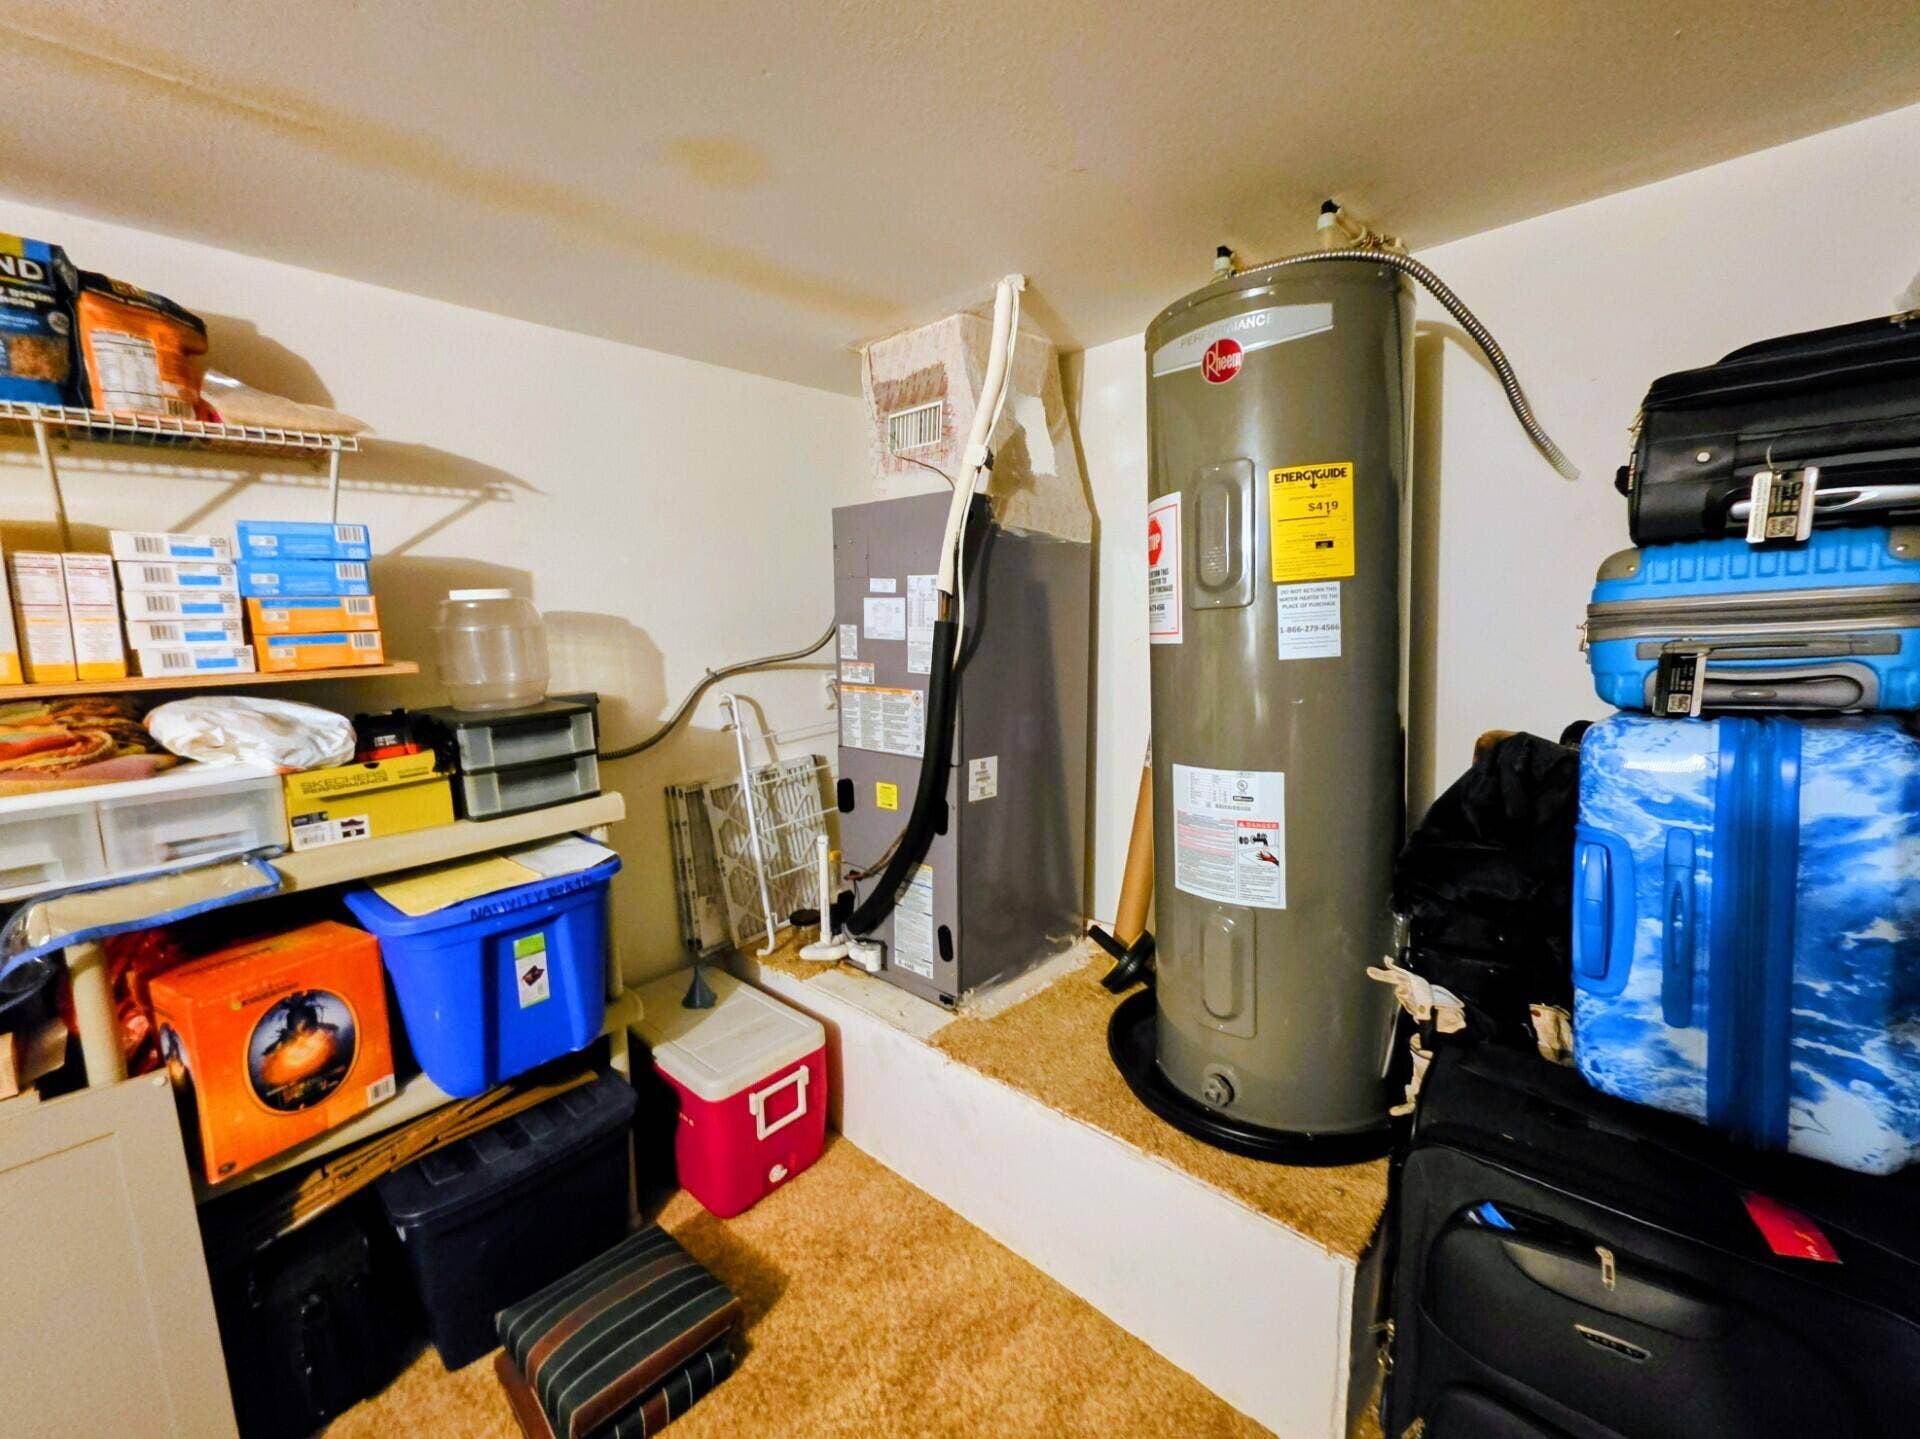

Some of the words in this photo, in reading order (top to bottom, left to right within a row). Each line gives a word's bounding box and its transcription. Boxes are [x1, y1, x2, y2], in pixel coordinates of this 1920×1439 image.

[1206, 341, 1241, 379] Rheem
[1274, 467, 1347, 485] ENERGYGUIDE
[301, 769, 389, 789] SKECHERS
[302, 779, 389, 795] PERFORMANCE
[470, 889, 544, 920] NATIVITY
